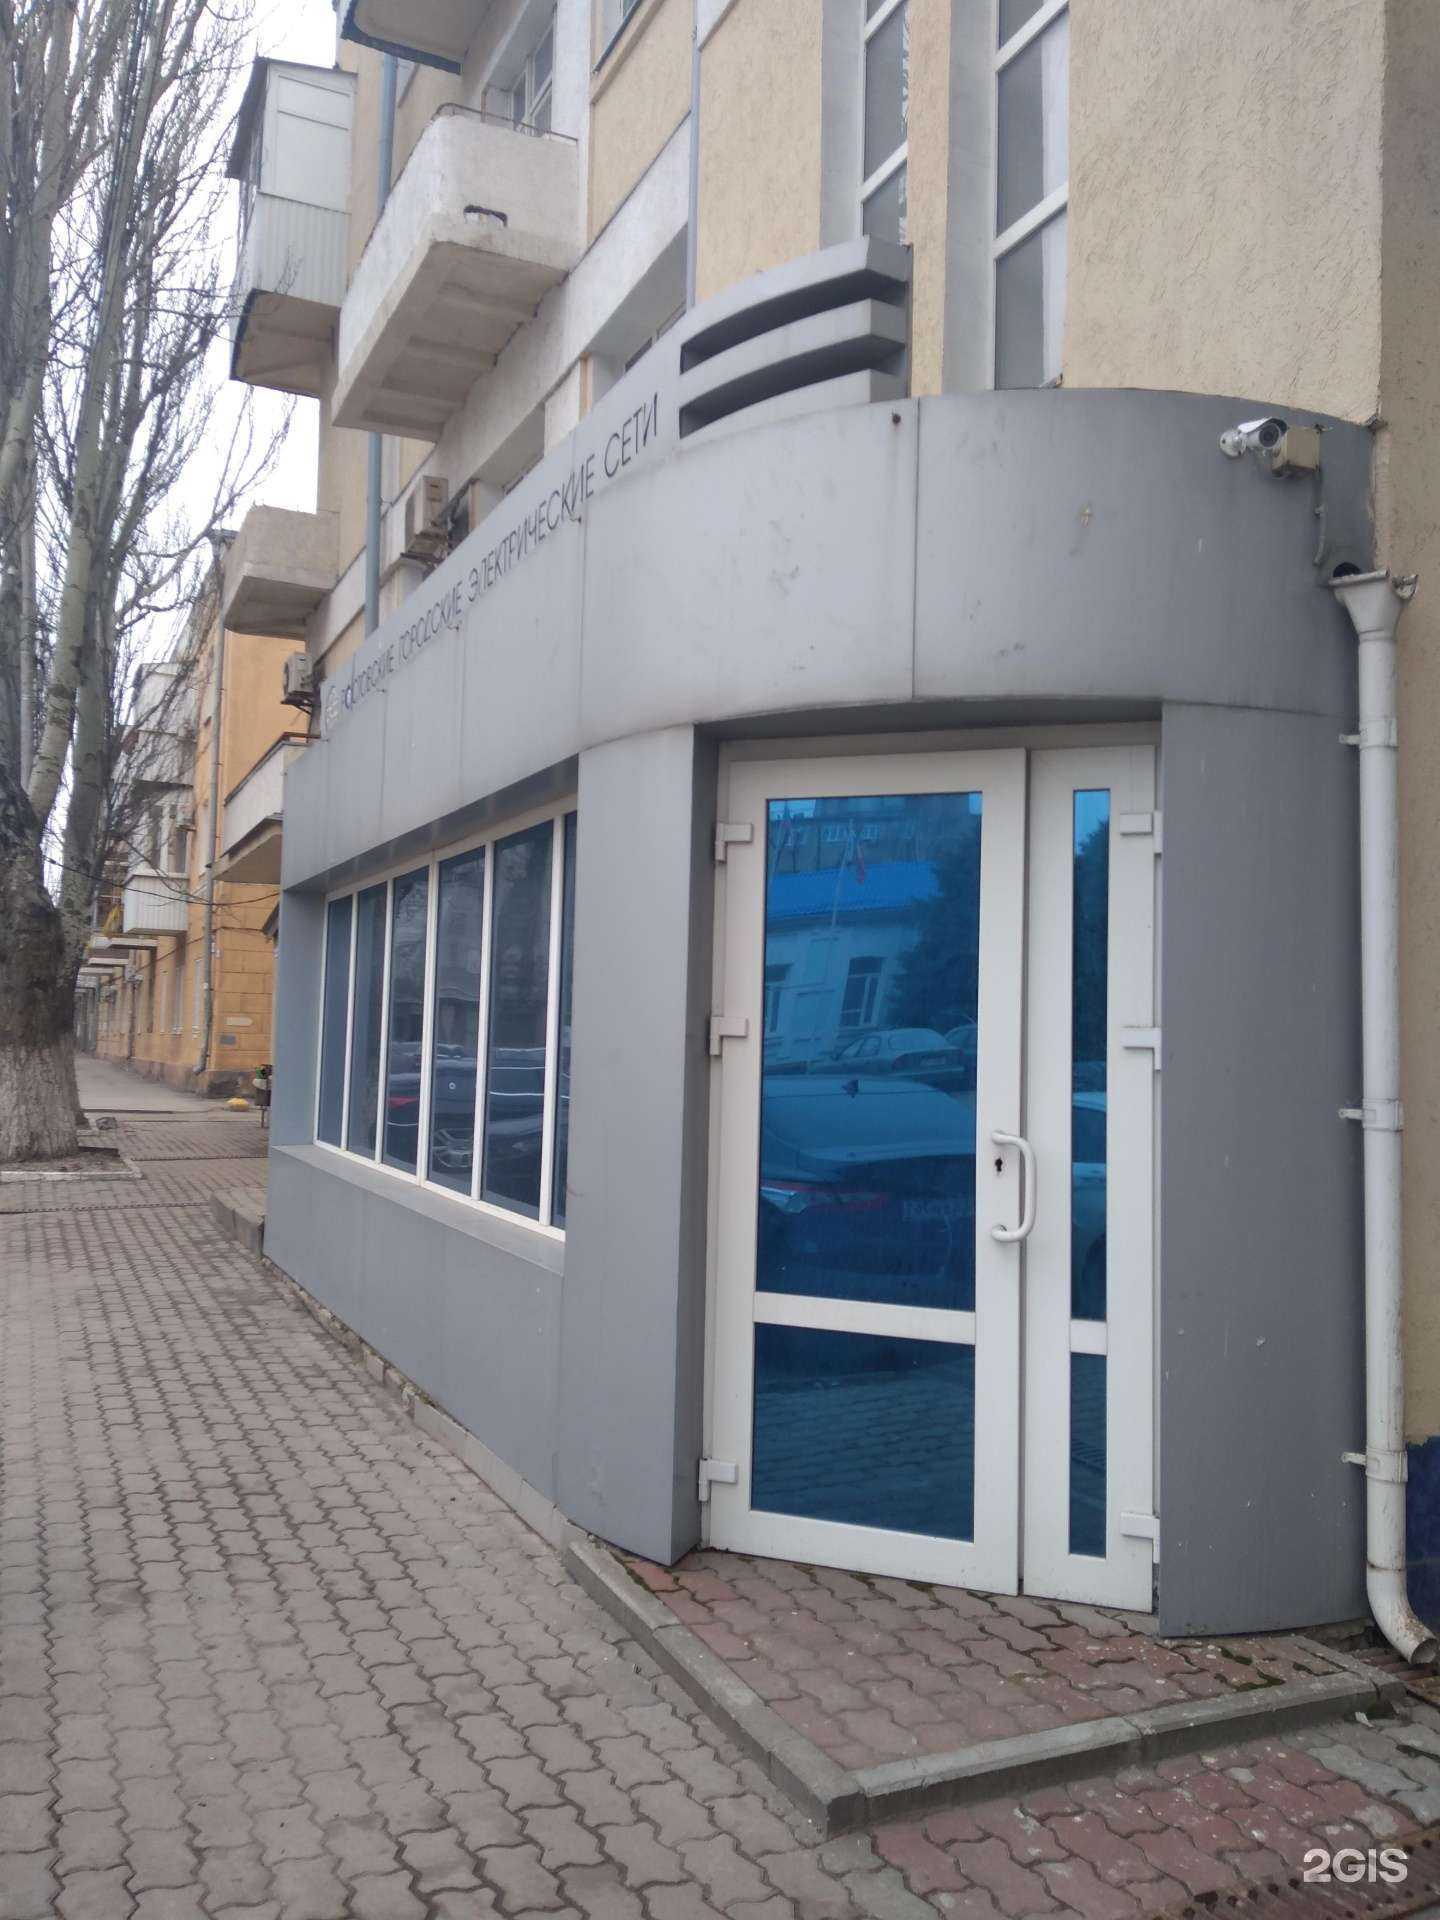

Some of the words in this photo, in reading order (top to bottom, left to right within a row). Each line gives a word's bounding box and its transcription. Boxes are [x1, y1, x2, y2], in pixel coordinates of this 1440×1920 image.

[399, 582, 463, 665] ГОРОДСКИЕ
[468, 455, 595, 602] ЭЛЕКТРИЧЕСКИЕ
[603, 392, 658, 478] СЕТИ
